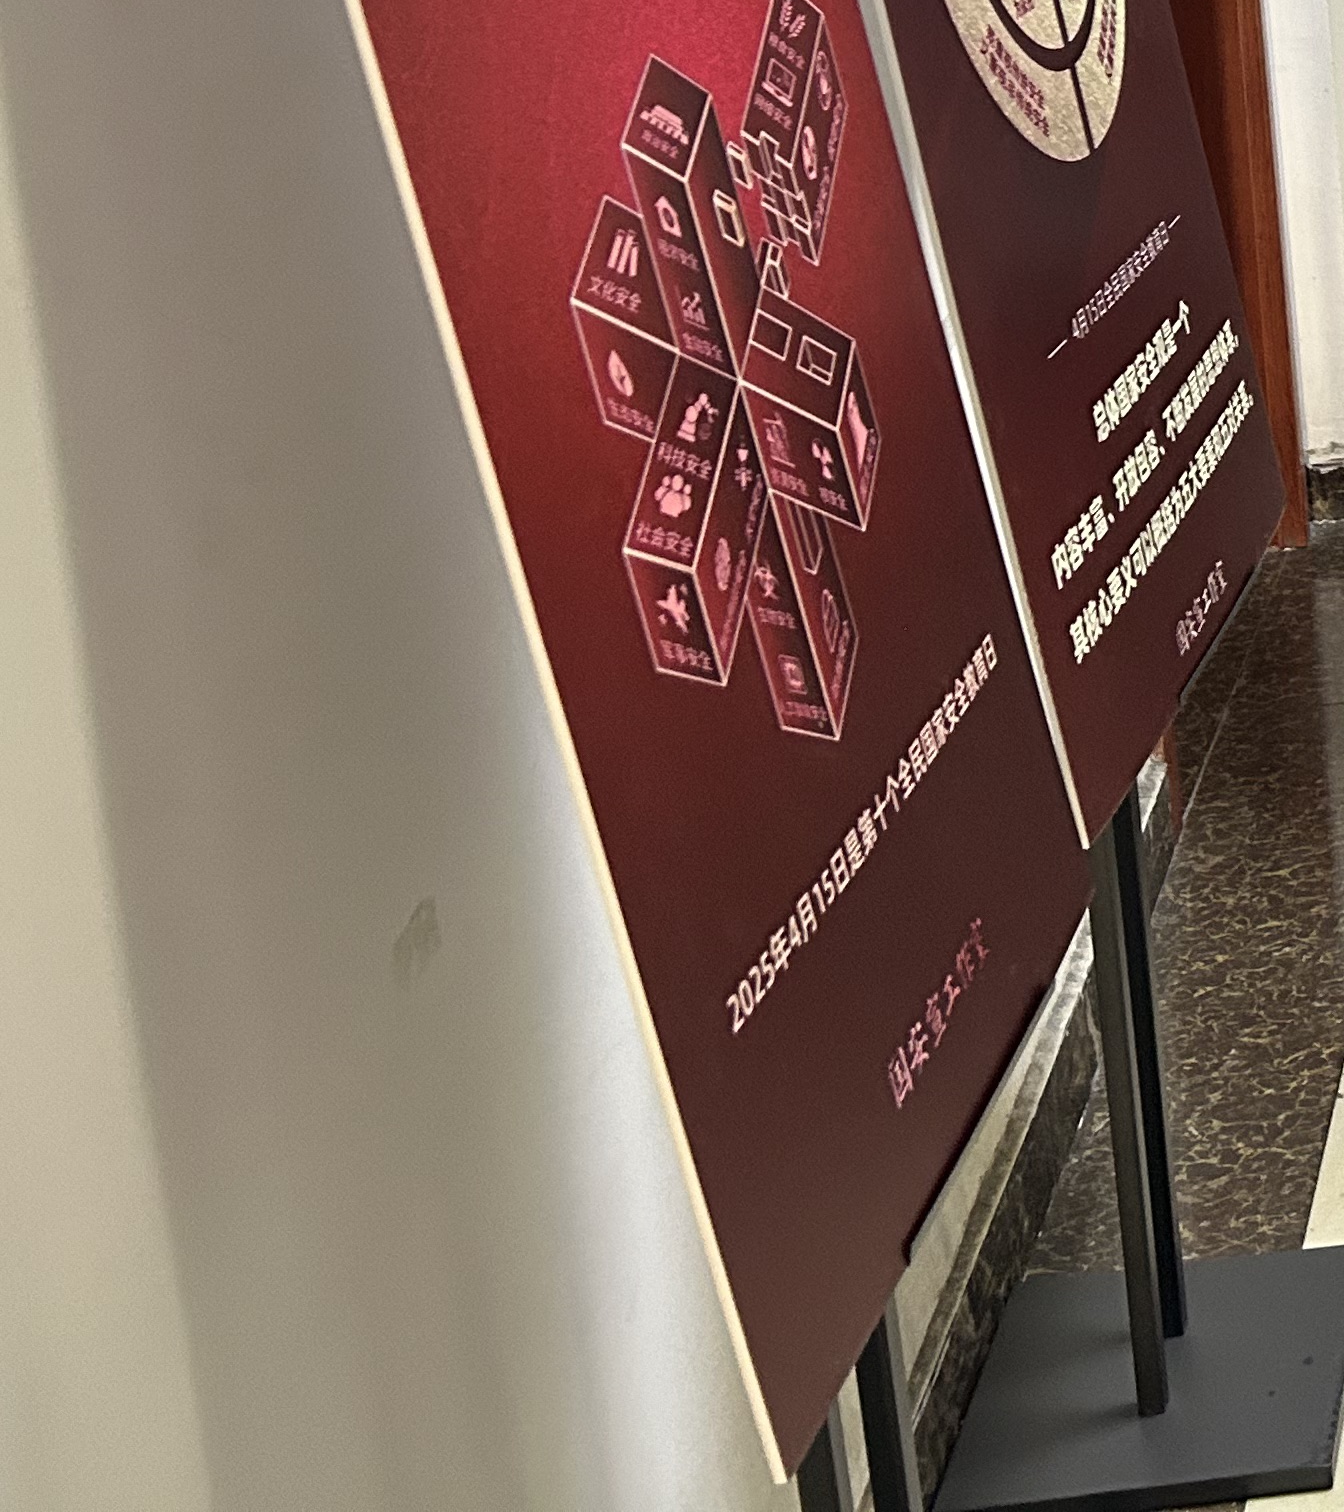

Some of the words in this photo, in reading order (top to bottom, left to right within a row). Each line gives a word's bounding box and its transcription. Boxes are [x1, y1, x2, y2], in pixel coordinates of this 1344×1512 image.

[587, 275, 643, 314] 文化安全
[1092, 300, 1190, 443] 总体国家安全观是一个
[635, 520, 694, 558] 社会安全
[725, 633, 998, 1035] 2025年4月15日是第十个全民国家安全教育日
